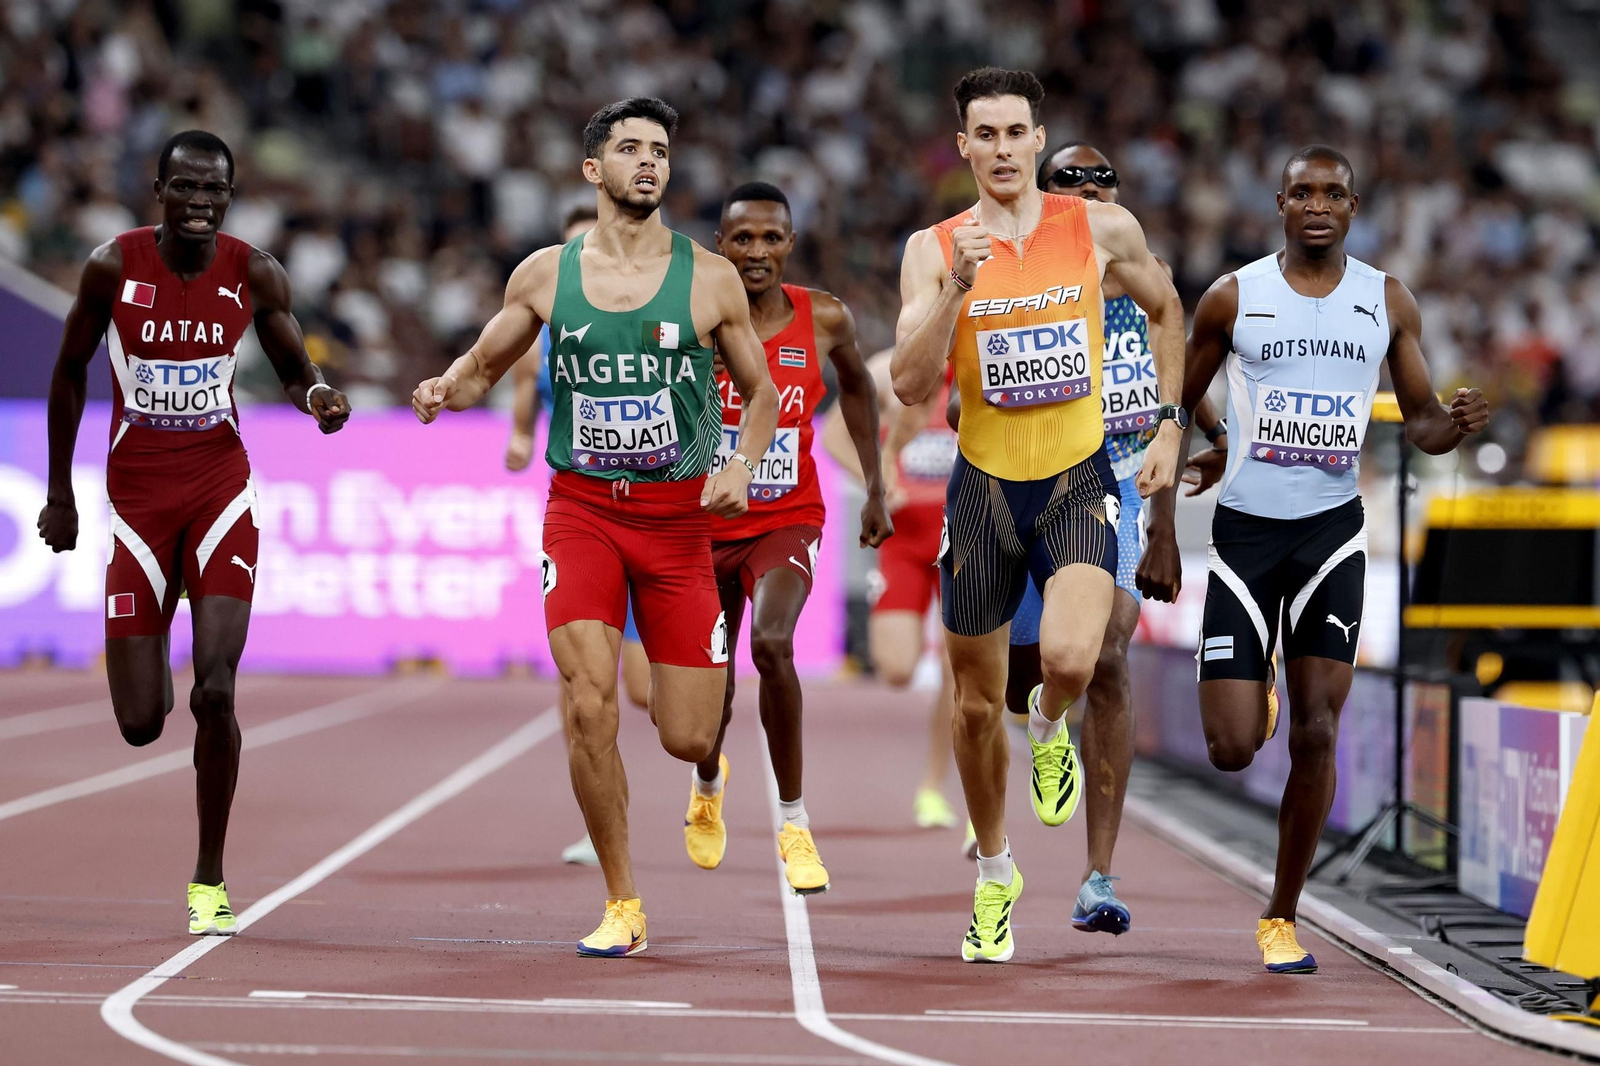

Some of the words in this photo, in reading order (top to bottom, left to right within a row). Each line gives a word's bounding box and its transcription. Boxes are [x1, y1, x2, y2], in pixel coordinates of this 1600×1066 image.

[968, 285, 1083, 317] ESPAÑA
[141, 320, 224, 345] QATAR
[1008, 323, 1082, 353] TDK
[1103, 331, 1142, 360] VG
[1261, 339, 1366, 363] BOTSWANA
[155, 360, 222, 386] TDK
[554, 354, 697, 385] ALGERIA
[987, 352, 1086, 387] BARROSO
[134, 384, 221, 412] CHUOT
[595, 394, 666, 422] TDK
[718, 380, 804, 415] KEYA
[1102, 384, 1160, 414] BAN
[1287, 391, 1356, 418] TDK
[579, 420, 673, 450] SEDJATI
[723, 429, 791, 453] TK
[1258, 417, 1358, 448] HAINGURA
